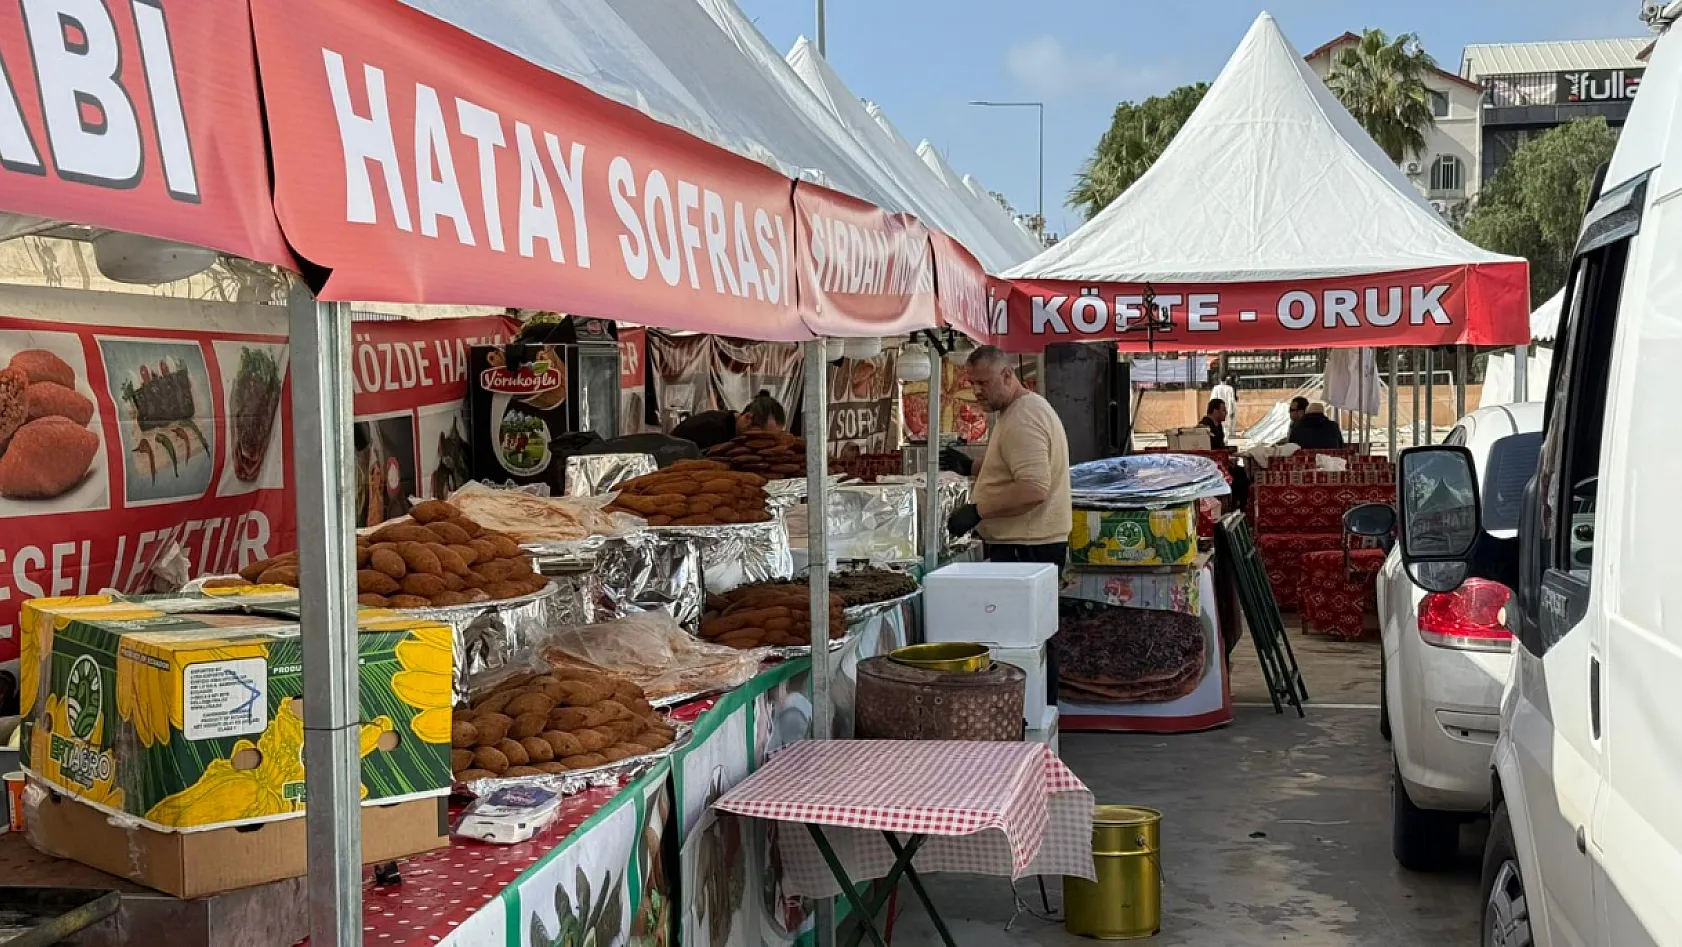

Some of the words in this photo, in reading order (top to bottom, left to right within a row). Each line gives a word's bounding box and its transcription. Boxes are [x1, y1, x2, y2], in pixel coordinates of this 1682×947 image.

[321, 47, 590, 269] HATAY
[608, 156, 789, 306] SOFRASI
[1031, 287, 1220, 334] KÖFTE
[1276, 284, 1452, 330] ORUK
[352, 333, 434, 393] ÖZDE
[273, 664, 302, 674] PRODU
